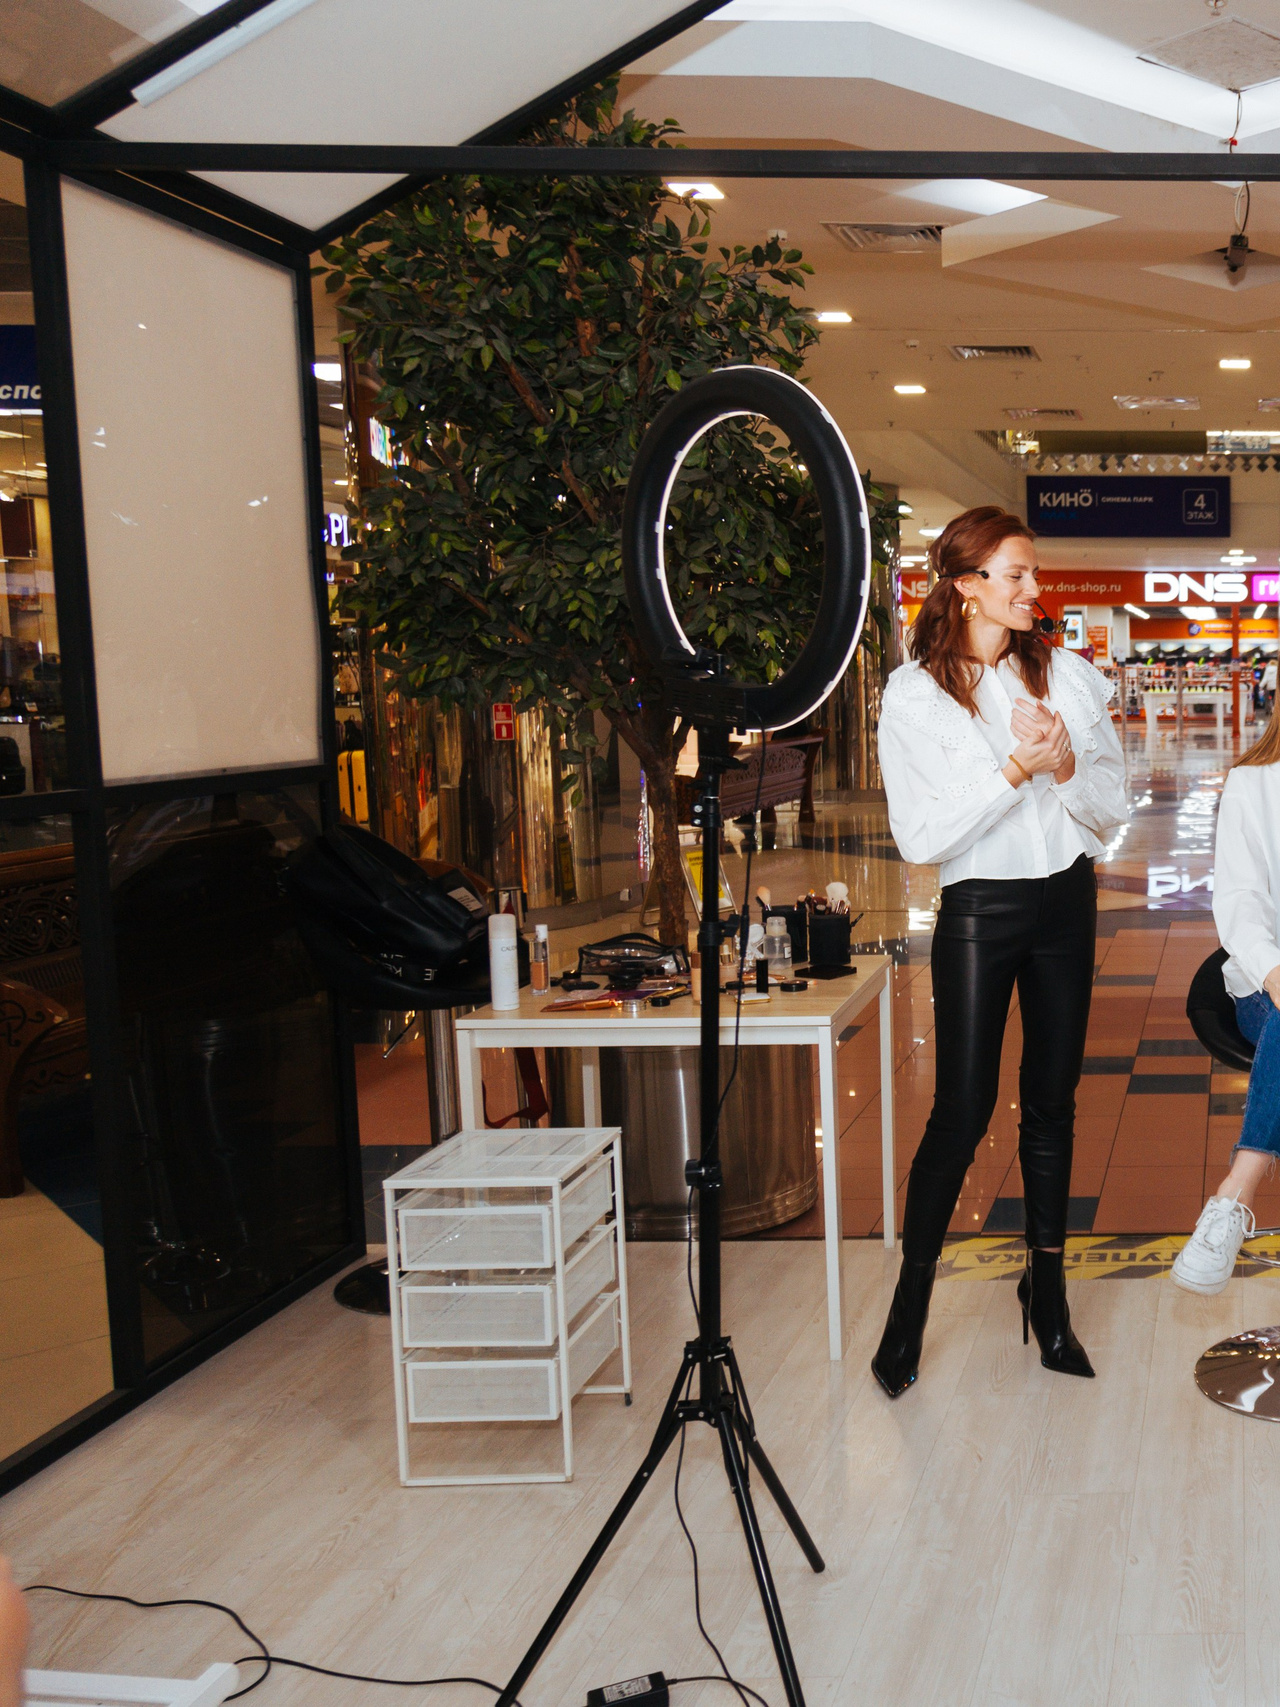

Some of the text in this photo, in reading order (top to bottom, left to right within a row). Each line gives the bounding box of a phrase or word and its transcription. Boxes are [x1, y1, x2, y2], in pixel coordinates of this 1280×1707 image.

[1194, 494, 1206, 509] 4
[1187, 511, 1214, 520] ЭТАЖ
[1039, 582, 1122, 594] ww.dns-shop.ru
[1144, 573, 1248, 602] DNS
